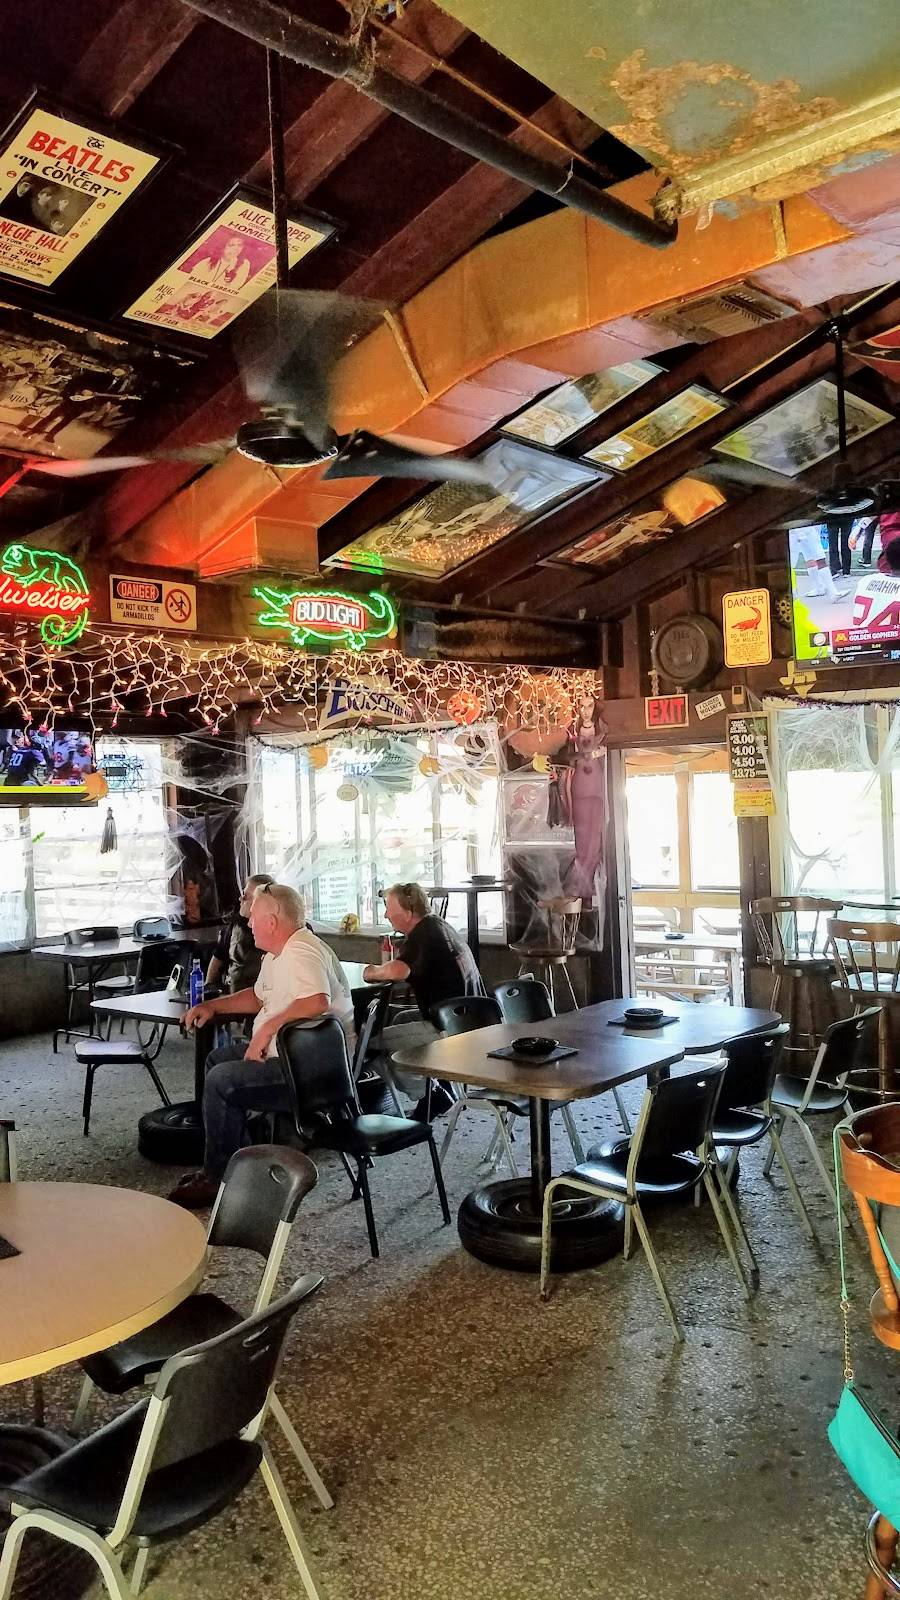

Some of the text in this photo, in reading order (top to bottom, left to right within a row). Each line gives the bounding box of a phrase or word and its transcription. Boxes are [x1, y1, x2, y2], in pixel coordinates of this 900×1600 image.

[27, 130, 135, 183] BEATLES
[54, 161, 94, 179] LIVE
[238, 208, 271, 227] ALICE
[35, 234, 68, 253] HALL
[17, 248, 51, 263] SHOWS
[188, 276, 208, 286] BLACK
[134, 310, 162, 321] CENTRAL
[121, 582, 157, 600] DANGER
[866, 580, 900, 594] IBRAHIM
[125, 603, 136, 612] NOT
[137, 604, 149, 612] KICK
[150, 605, 160, 614] THE
[727, 595, 764, 609] DANGER
[122, 611, 155, 621] ARMADILLOS
[297, 601, 361, 627] BUD LIGHT
[742, 635, 761, 643] MOLEST
[849, 630, 899, 642] GOLDEN GOPHERS
[649, 698, 684, 724] EXIT
